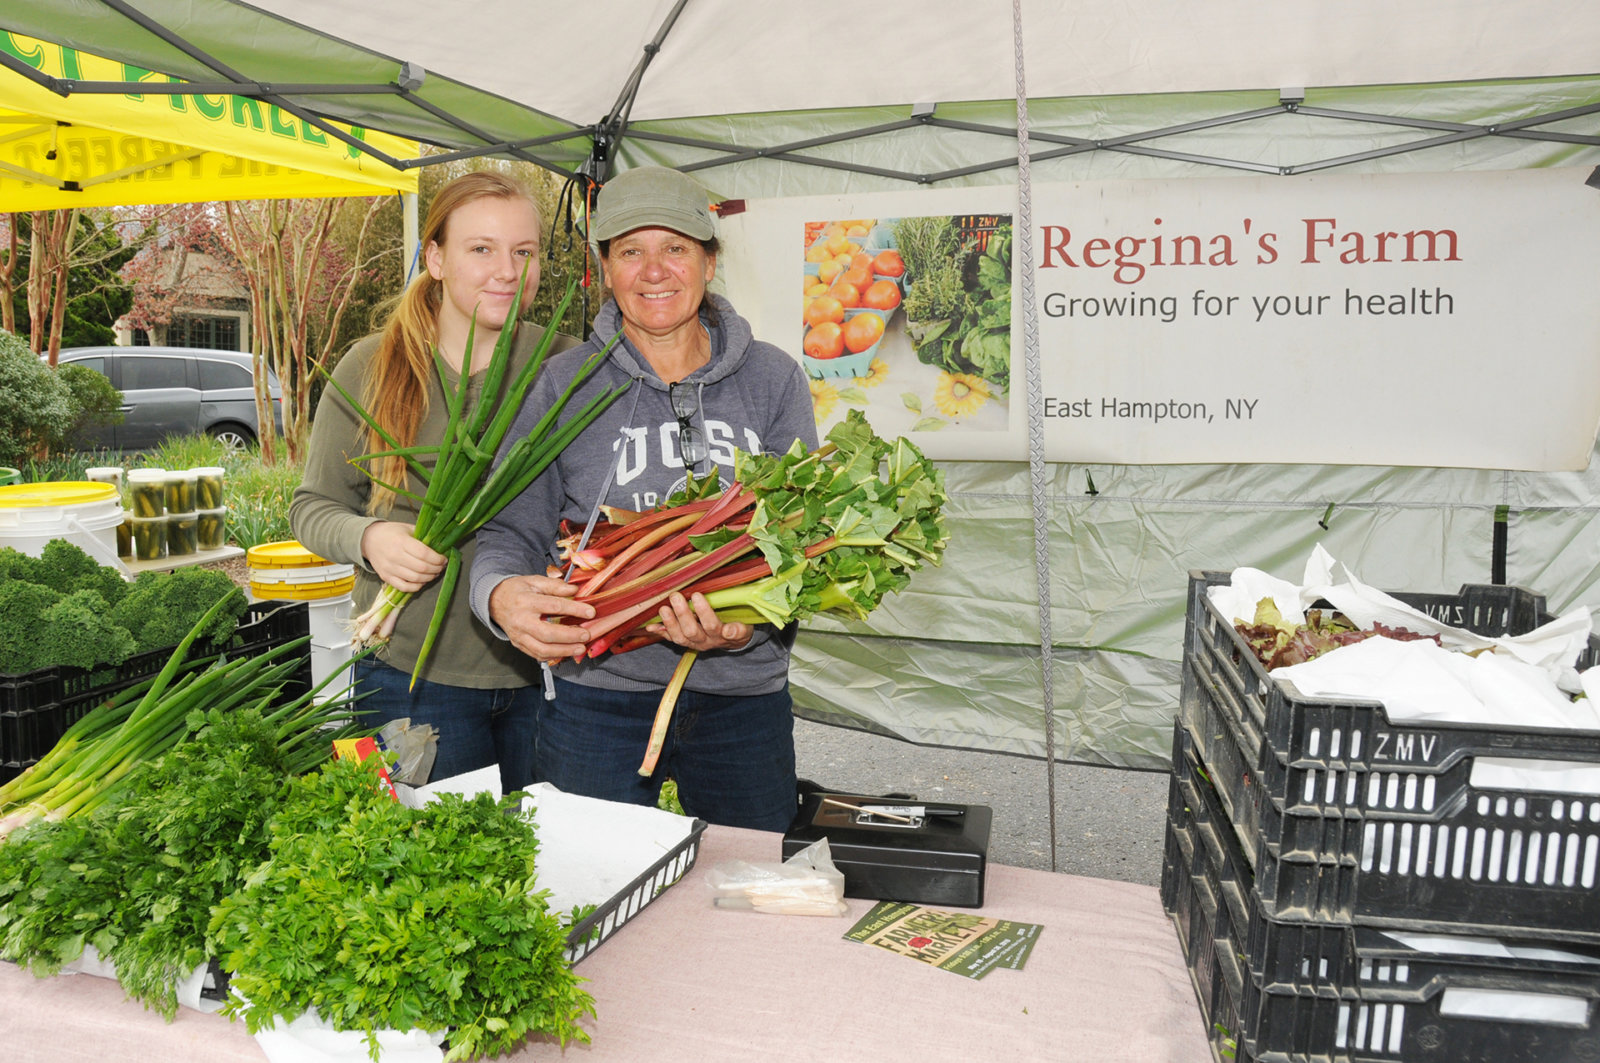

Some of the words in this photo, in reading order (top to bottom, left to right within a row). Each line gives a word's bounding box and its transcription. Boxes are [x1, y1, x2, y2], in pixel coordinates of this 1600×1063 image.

[978, 216, 999, 227] ZMV
[1038, 217, 1279, 285] Regina's
[1300, 218, 1463, 265] Farm
[1043, 291, 1177, 323] Growing
[1192, 290, 1240, 316] for
[1252, 295, 1331, 322] your
[1344, 287, 1454, 315] health
[1043, 397, 1092, 418] East
[1101, 397, 1214, 424] Hampton,
[1225, 399, 1259, 420] NY
[1374, 732, 1437, 762] ZMV
[904, 922, 978, 964] MARKET
